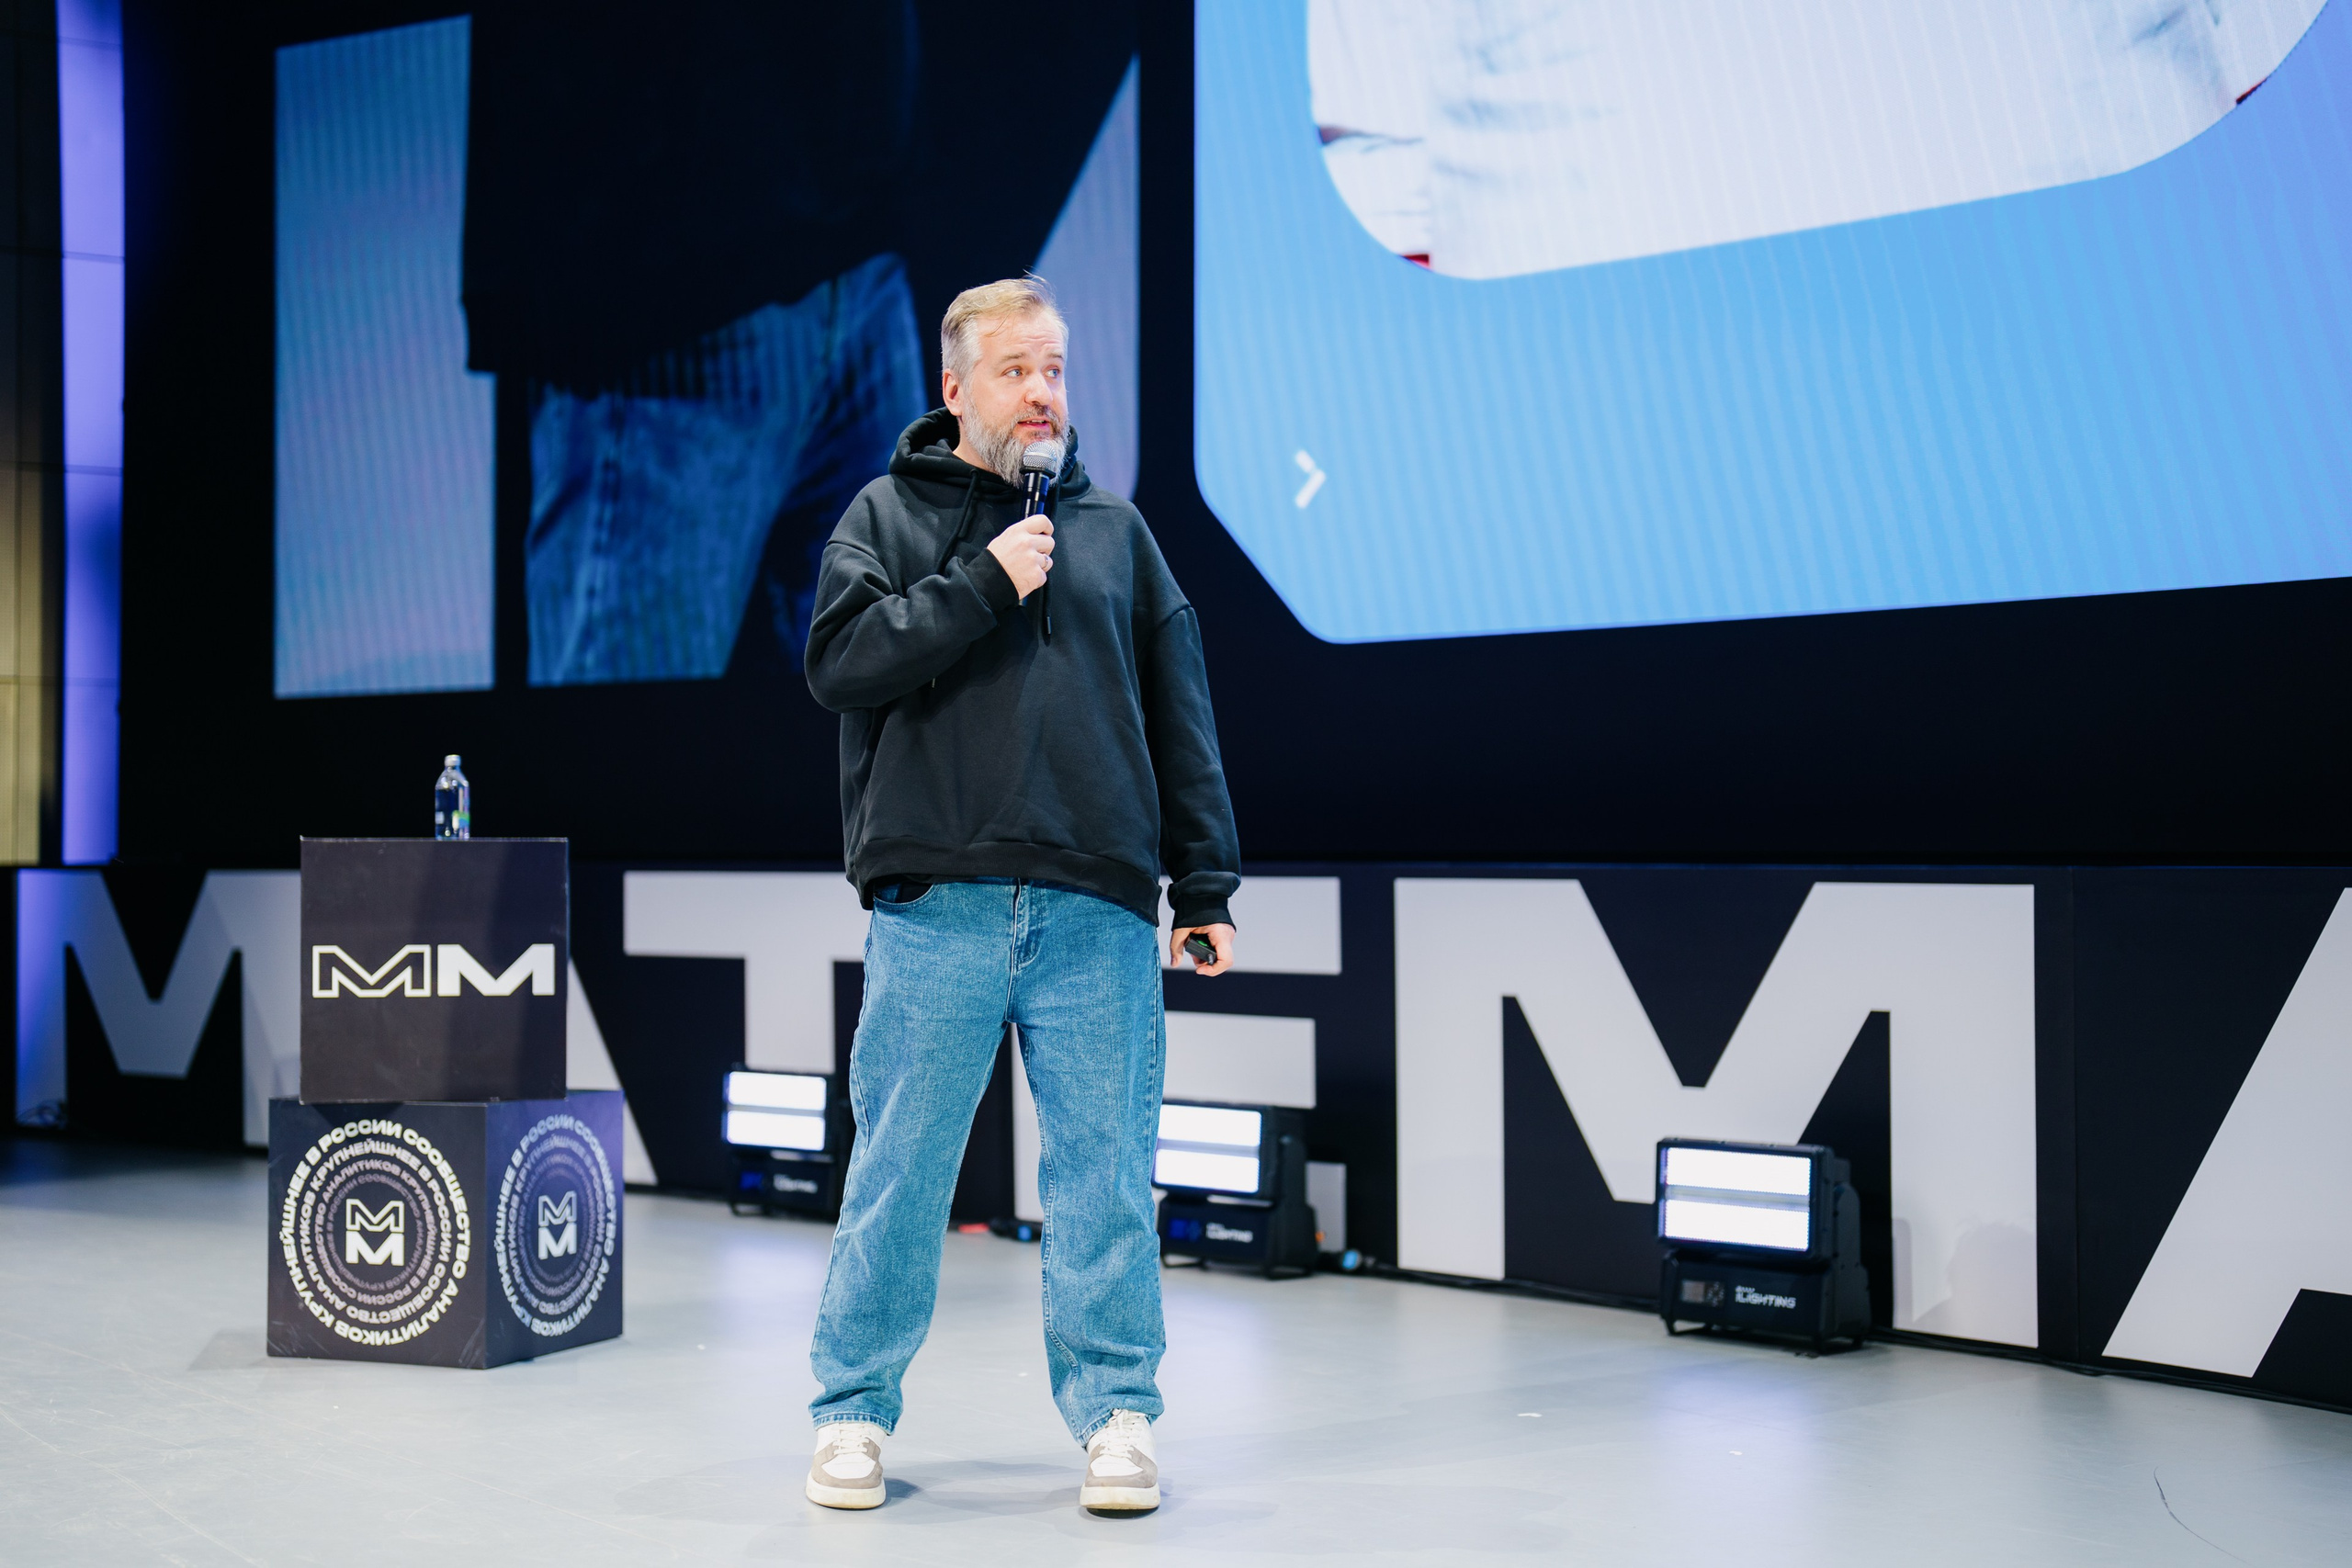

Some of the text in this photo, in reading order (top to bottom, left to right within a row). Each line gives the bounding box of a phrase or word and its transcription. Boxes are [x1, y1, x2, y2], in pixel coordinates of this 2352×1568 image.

[304, 1145, 321, 1166] В
[318, 1119, 401, 1152] РОССИИ
[520, 1114, 574, 1152] РОССИИ
[403, 1129, 469, 1278] СООБЩЕСТВО
[417, 1165, 431, 1181] В
[300, 1190, 346, 1310] АНАЛИТИКОВ
[427, 1179, 451, 1261] РОССИИ
[334, 1279, 458, 1345] АНАЛИТИКОВ
[346, 1262, 445, 1324] СООБЩЕСТВО
